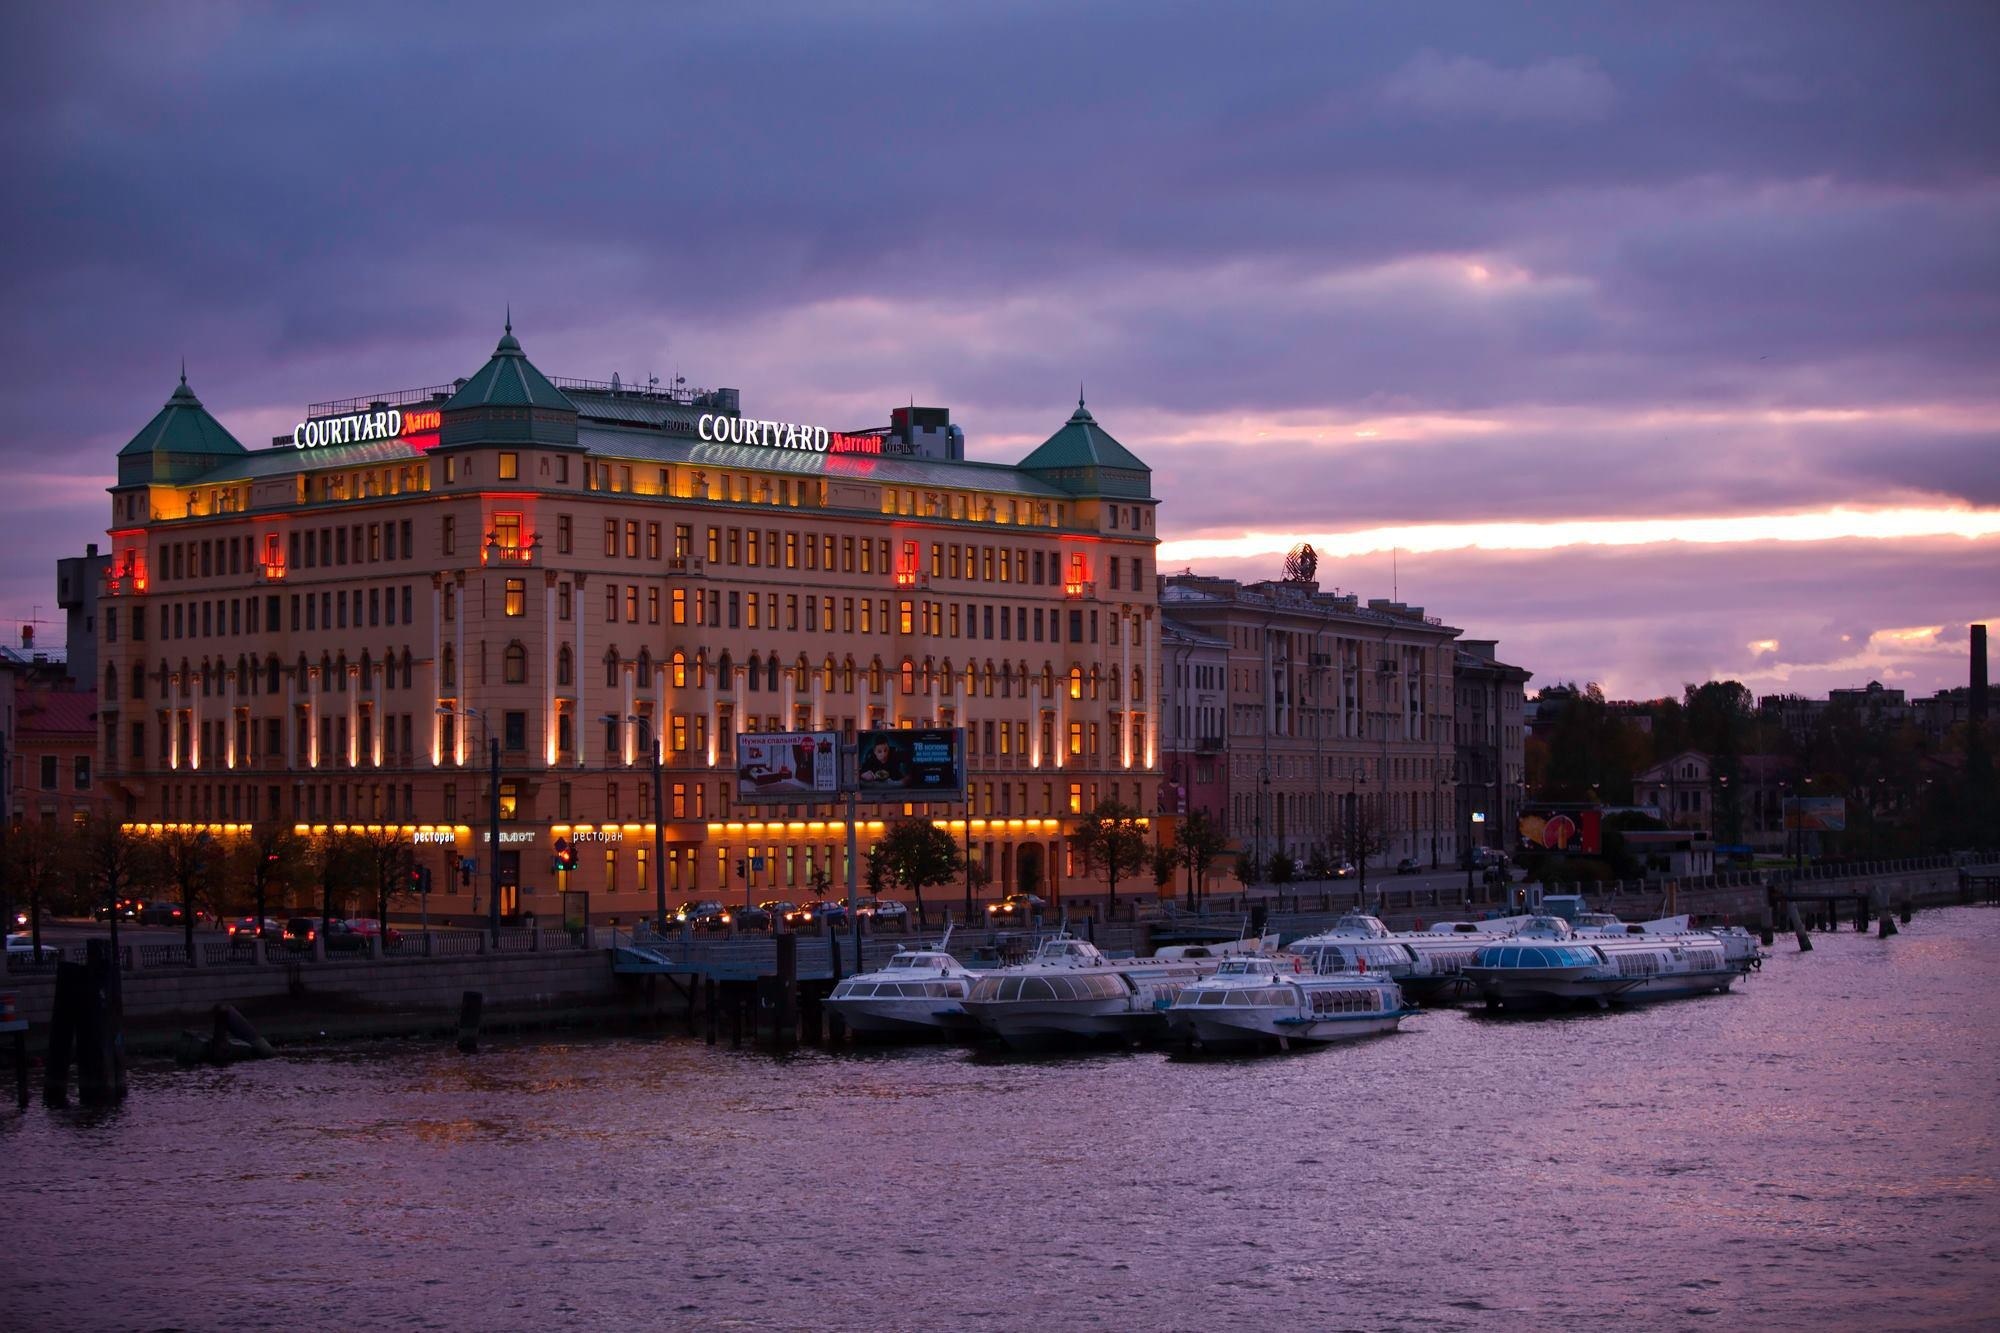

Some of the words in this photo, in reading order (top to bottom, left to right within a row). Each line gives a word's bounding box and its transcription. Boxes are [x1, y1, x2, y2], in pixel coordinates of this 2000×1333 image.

[294, 410, 401, 449] COURTYARD
[698, 413, 829, 453] COURTYARD
[830, 433, 882, 453] Marriott
[414, 832, 455, 845] ресторан
[573, 832, 623, 844] ресторан
